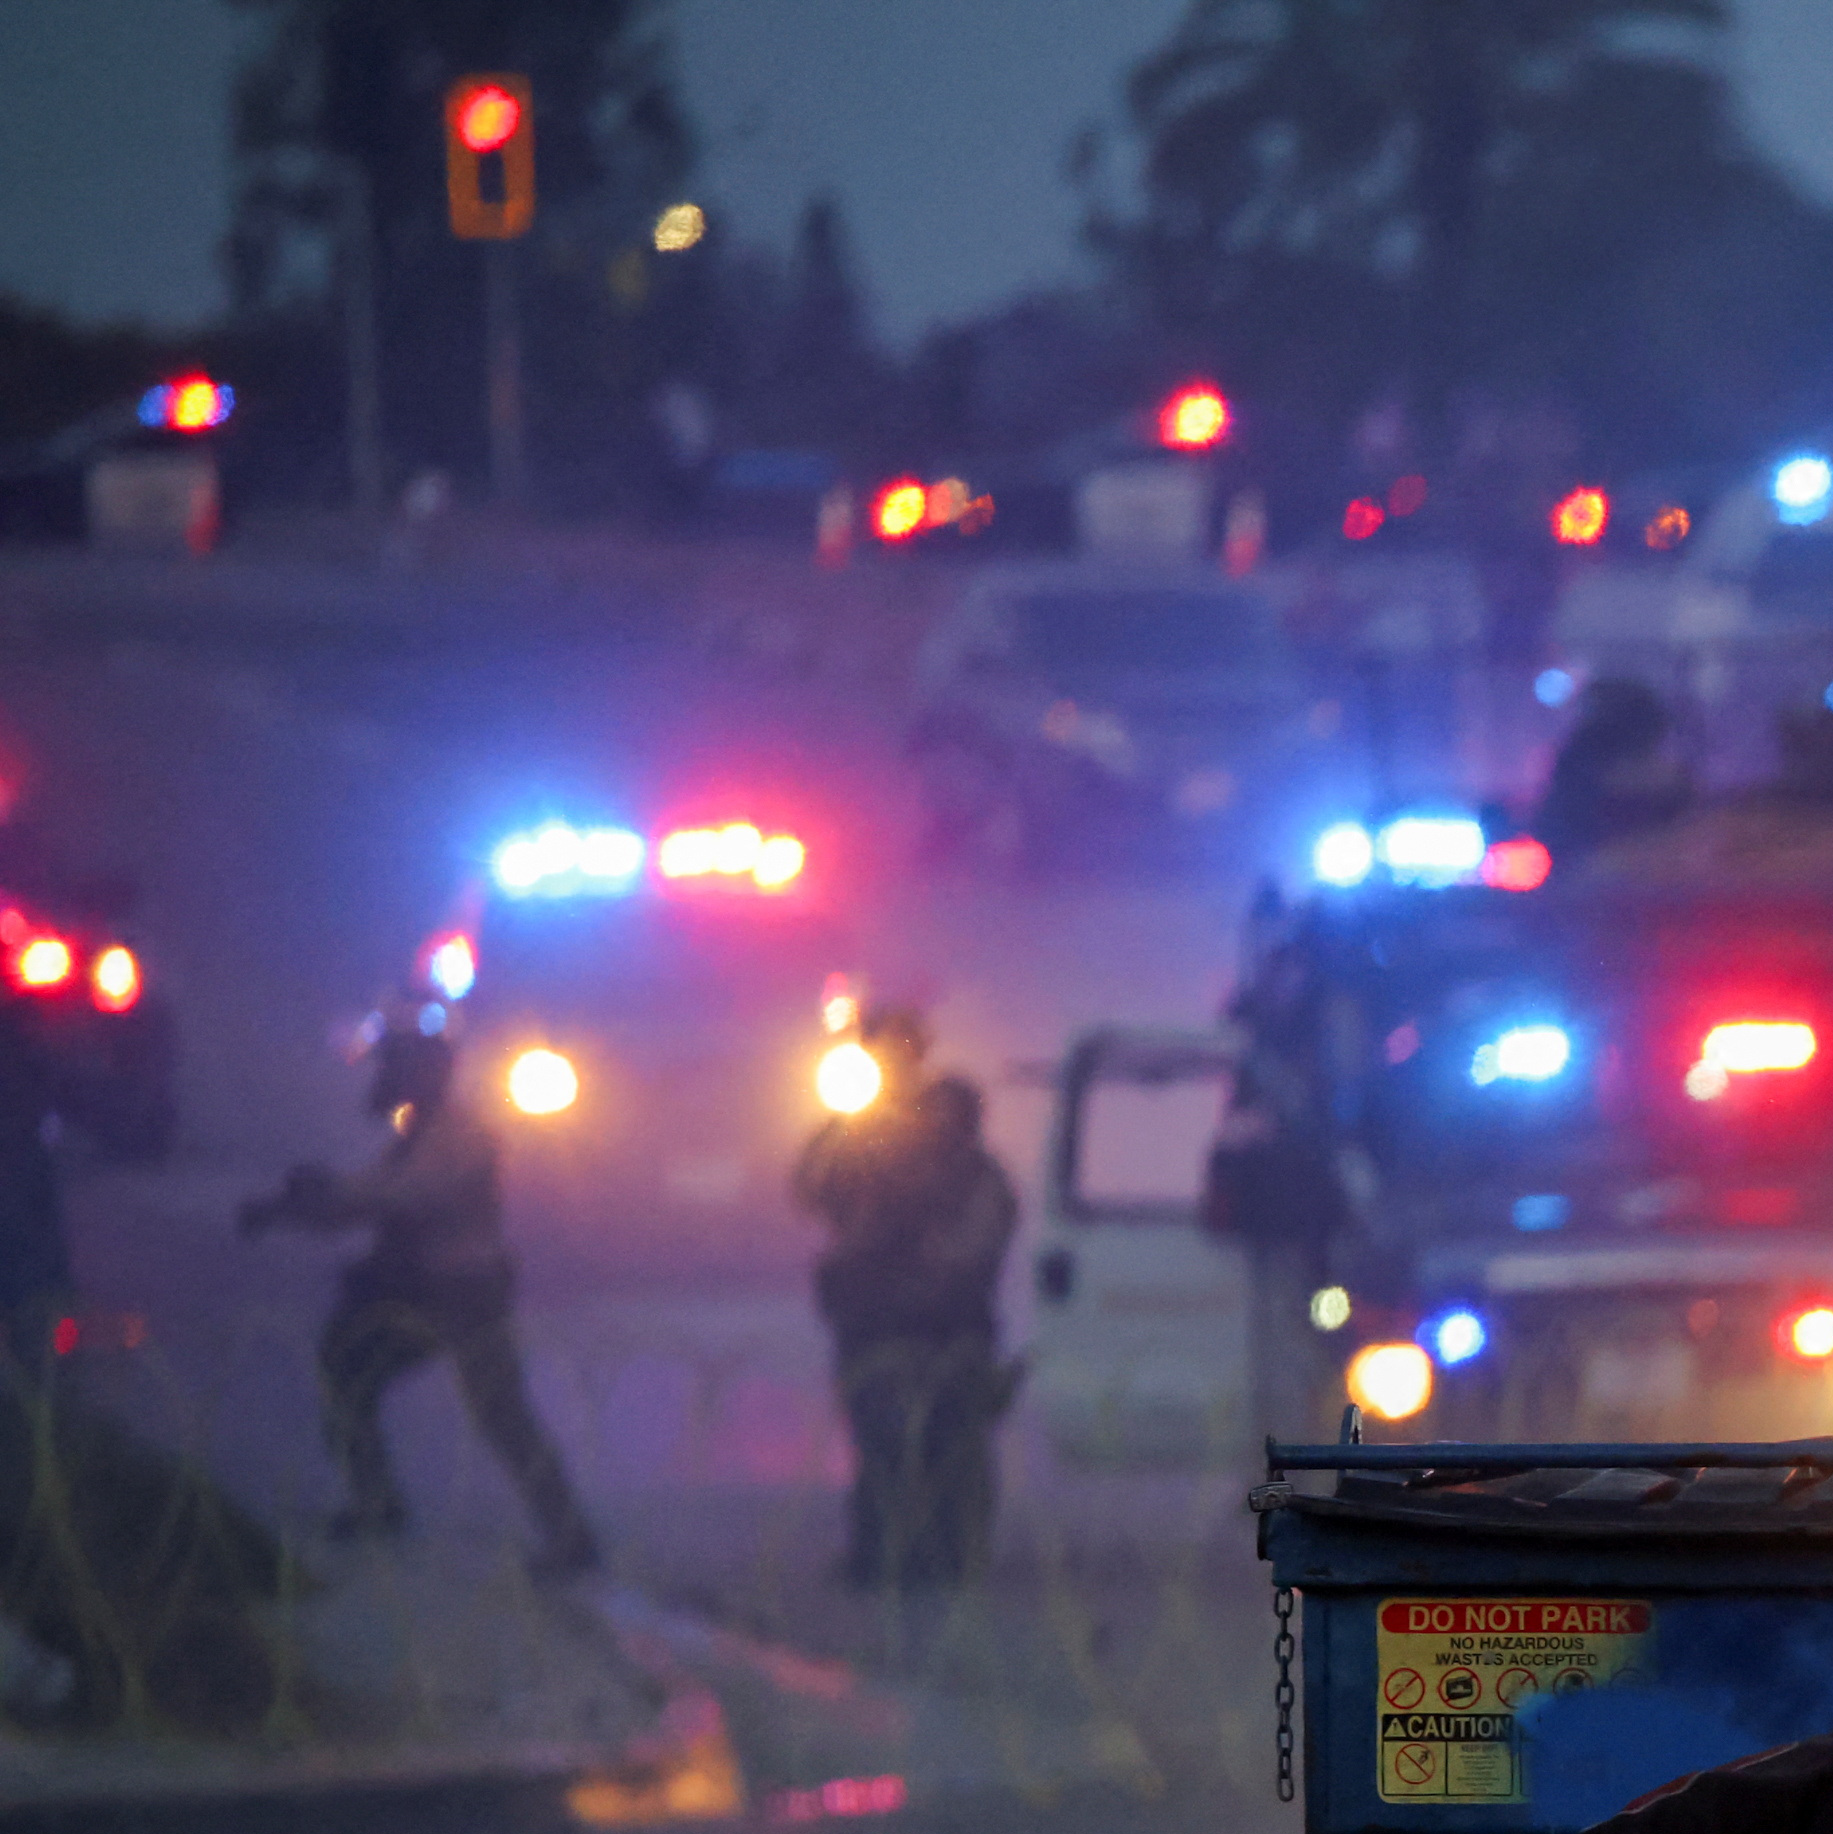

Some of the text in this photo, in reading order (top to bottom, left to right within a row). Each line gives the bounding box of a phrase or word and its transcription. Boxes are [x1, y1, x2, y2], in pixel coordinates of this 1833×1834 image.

[1408, 1604, 1631, 1632] DO NOT PARK
[1450, 1636, 1585, 1650] NO HAZARDOUS
[1508, 1653, 1598, 1666] ACCEPTED
[1406, 1714, 1511, 1739] CAUTION
